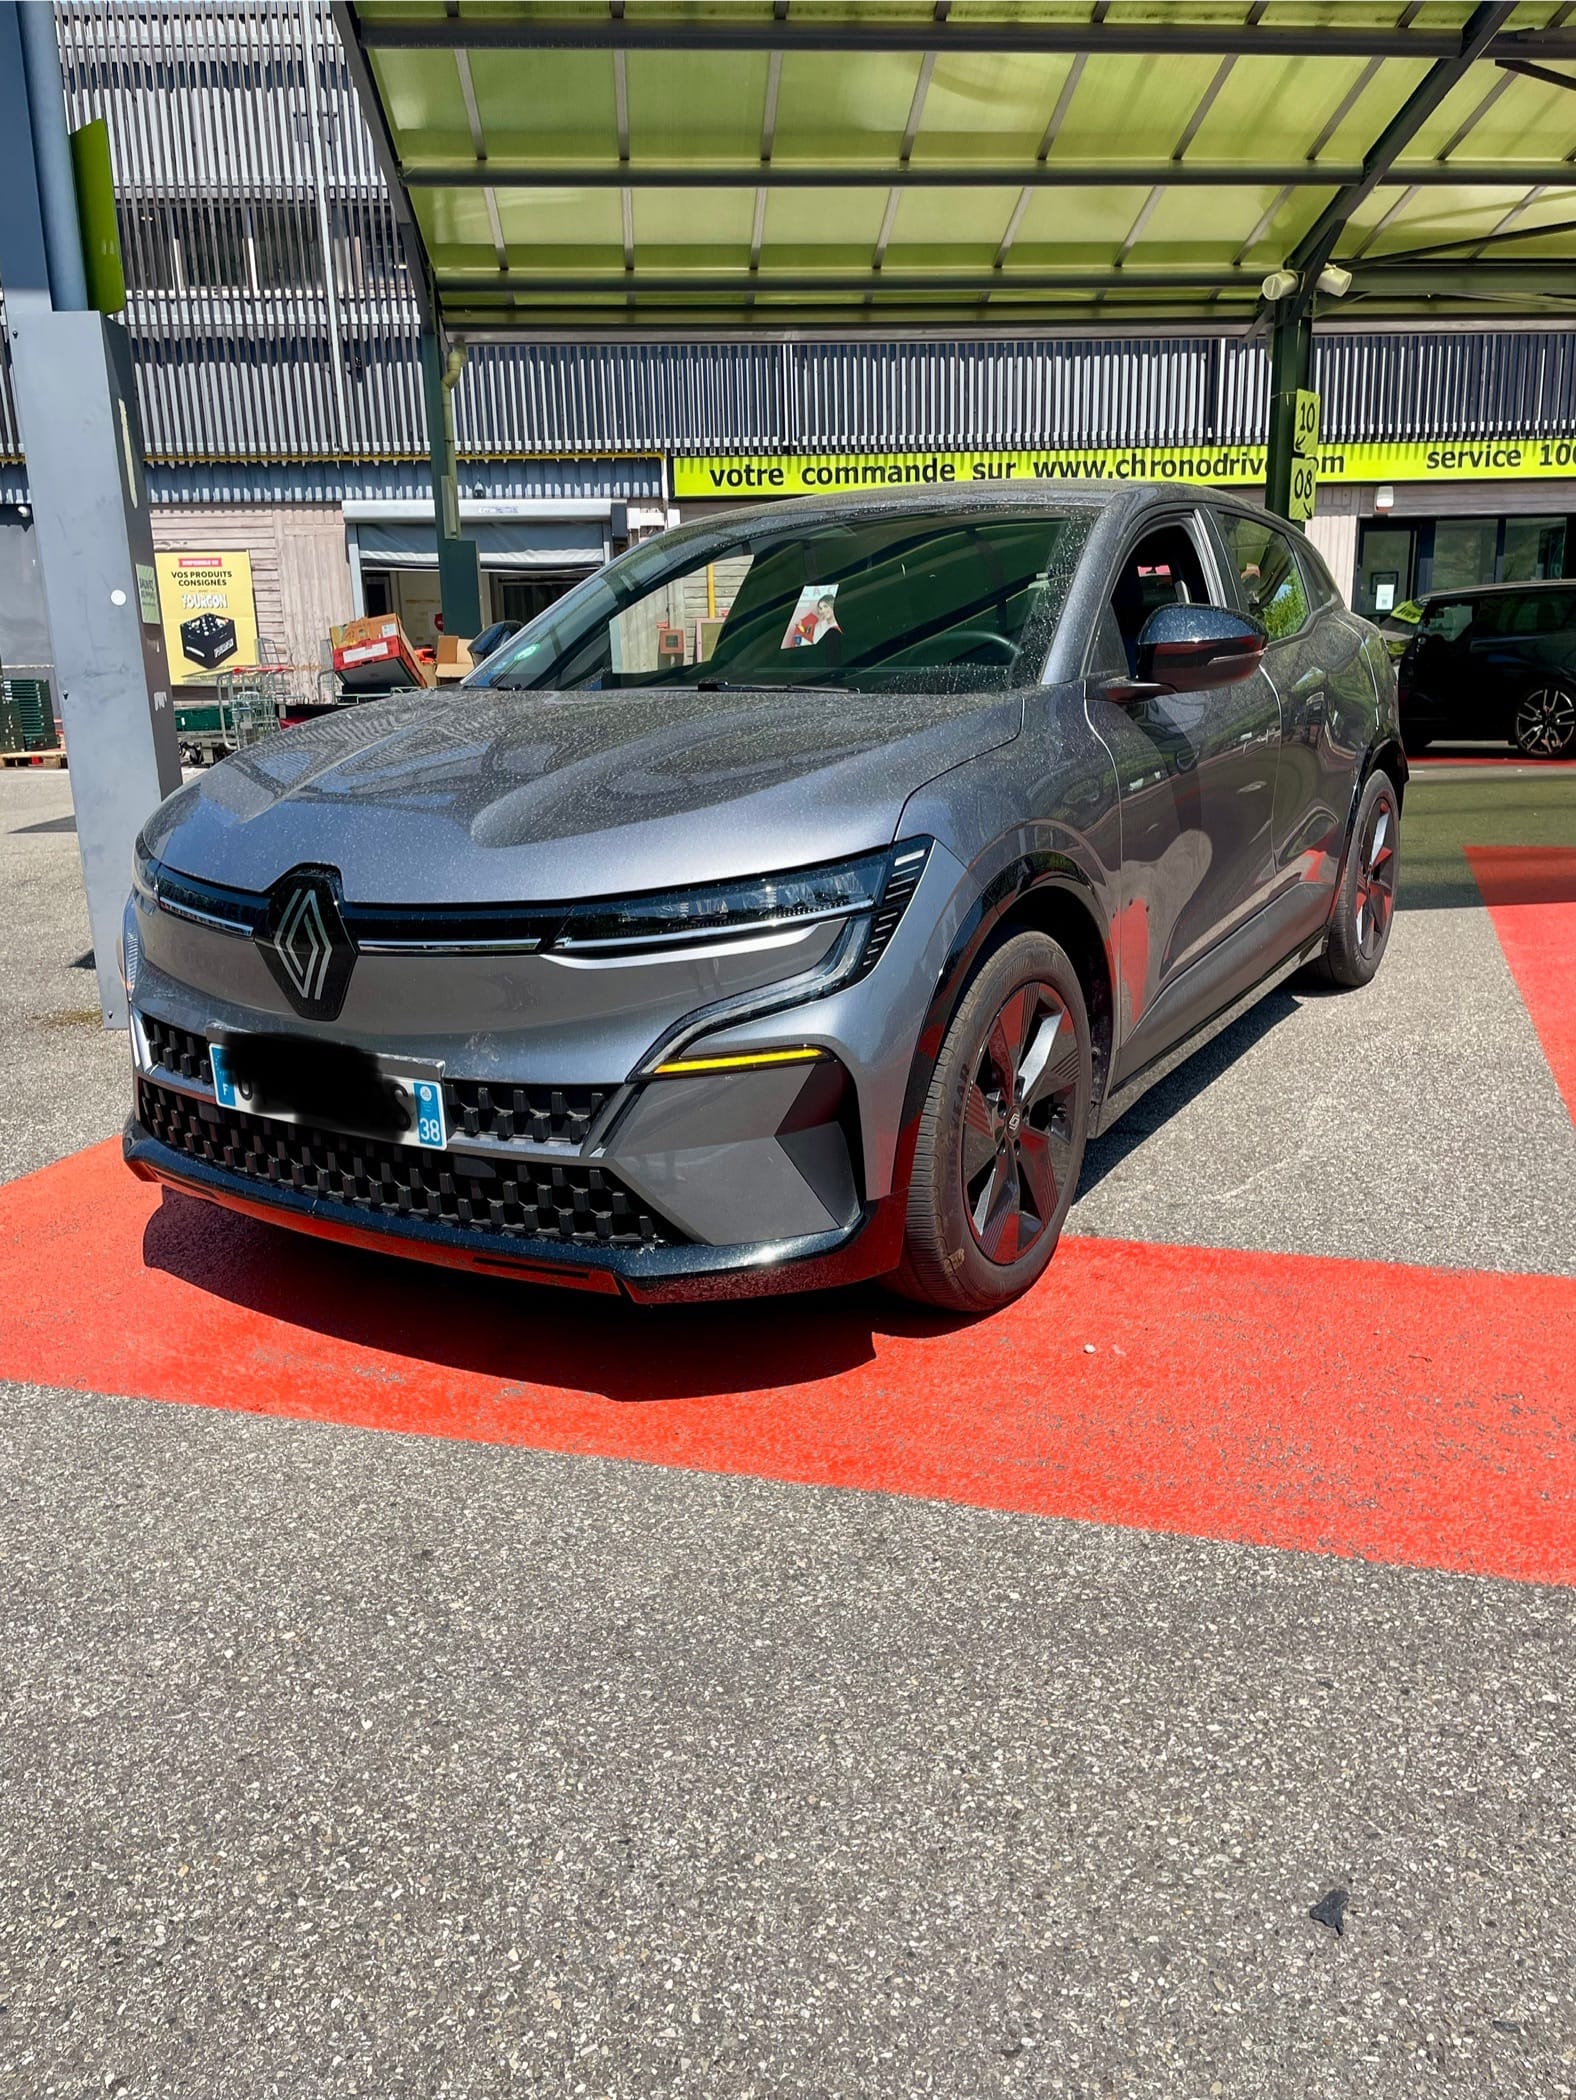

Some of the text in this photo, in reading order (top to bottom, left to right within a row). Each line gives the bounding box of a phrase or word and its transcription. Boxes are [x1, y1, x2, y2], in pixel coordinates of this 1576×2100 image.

[1300, 402, 1315, 433] 10
[709, 443, 1576, 487] votre commande sur www.chronodrivm service 10
[1294, 468, 1312, 499] 08
[171, 570, 232, 579] VOS PRODUITS
[178, 579, 227, 587] CONSIGNÉS
[222, 1082, 229, 1095] F
[419, 1117, 441, 1142] 38
